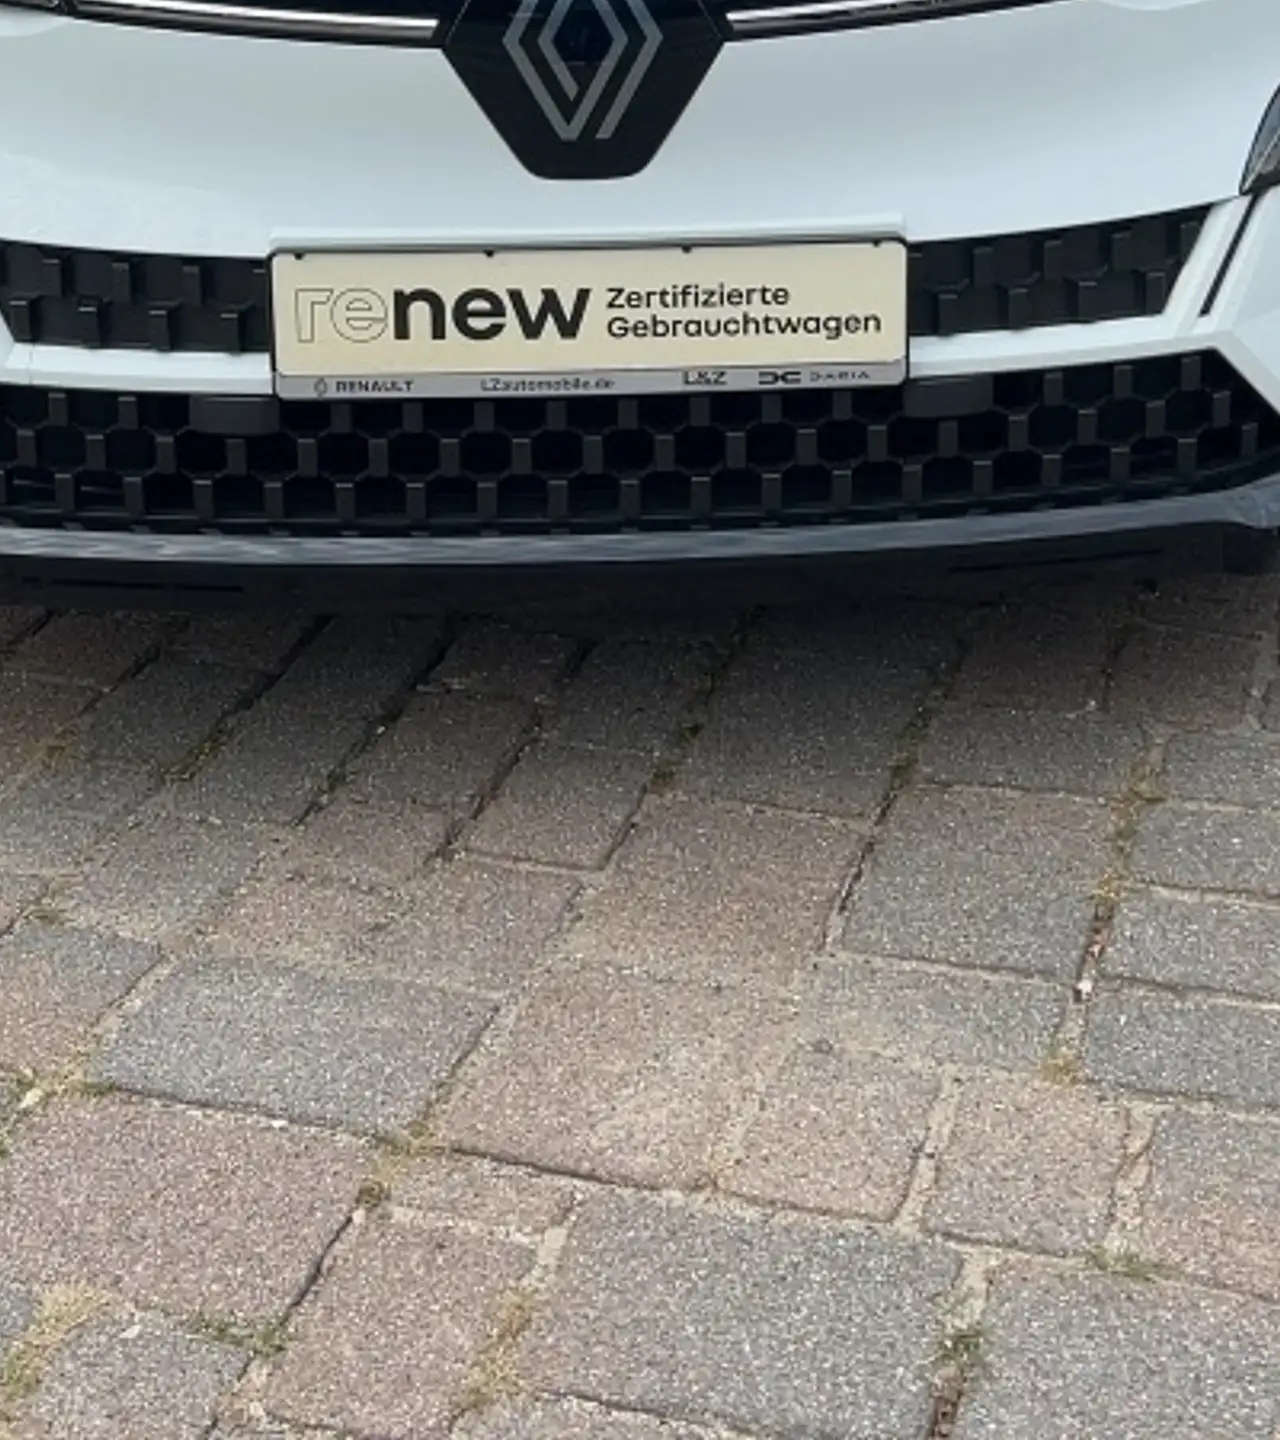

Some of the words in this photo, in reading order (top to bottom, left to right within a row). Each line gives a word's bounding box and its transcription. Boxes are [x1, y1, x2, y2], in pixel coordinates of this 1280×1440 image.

[605, 282, 791, 310] Zertifizierte
[294, 287, 592, 344] renew
[606, 311, 882, 341] Gebrauchtwagen
[335, 379, 415, 393] RENAULT
[682, 370, 728, 386] L&Z
